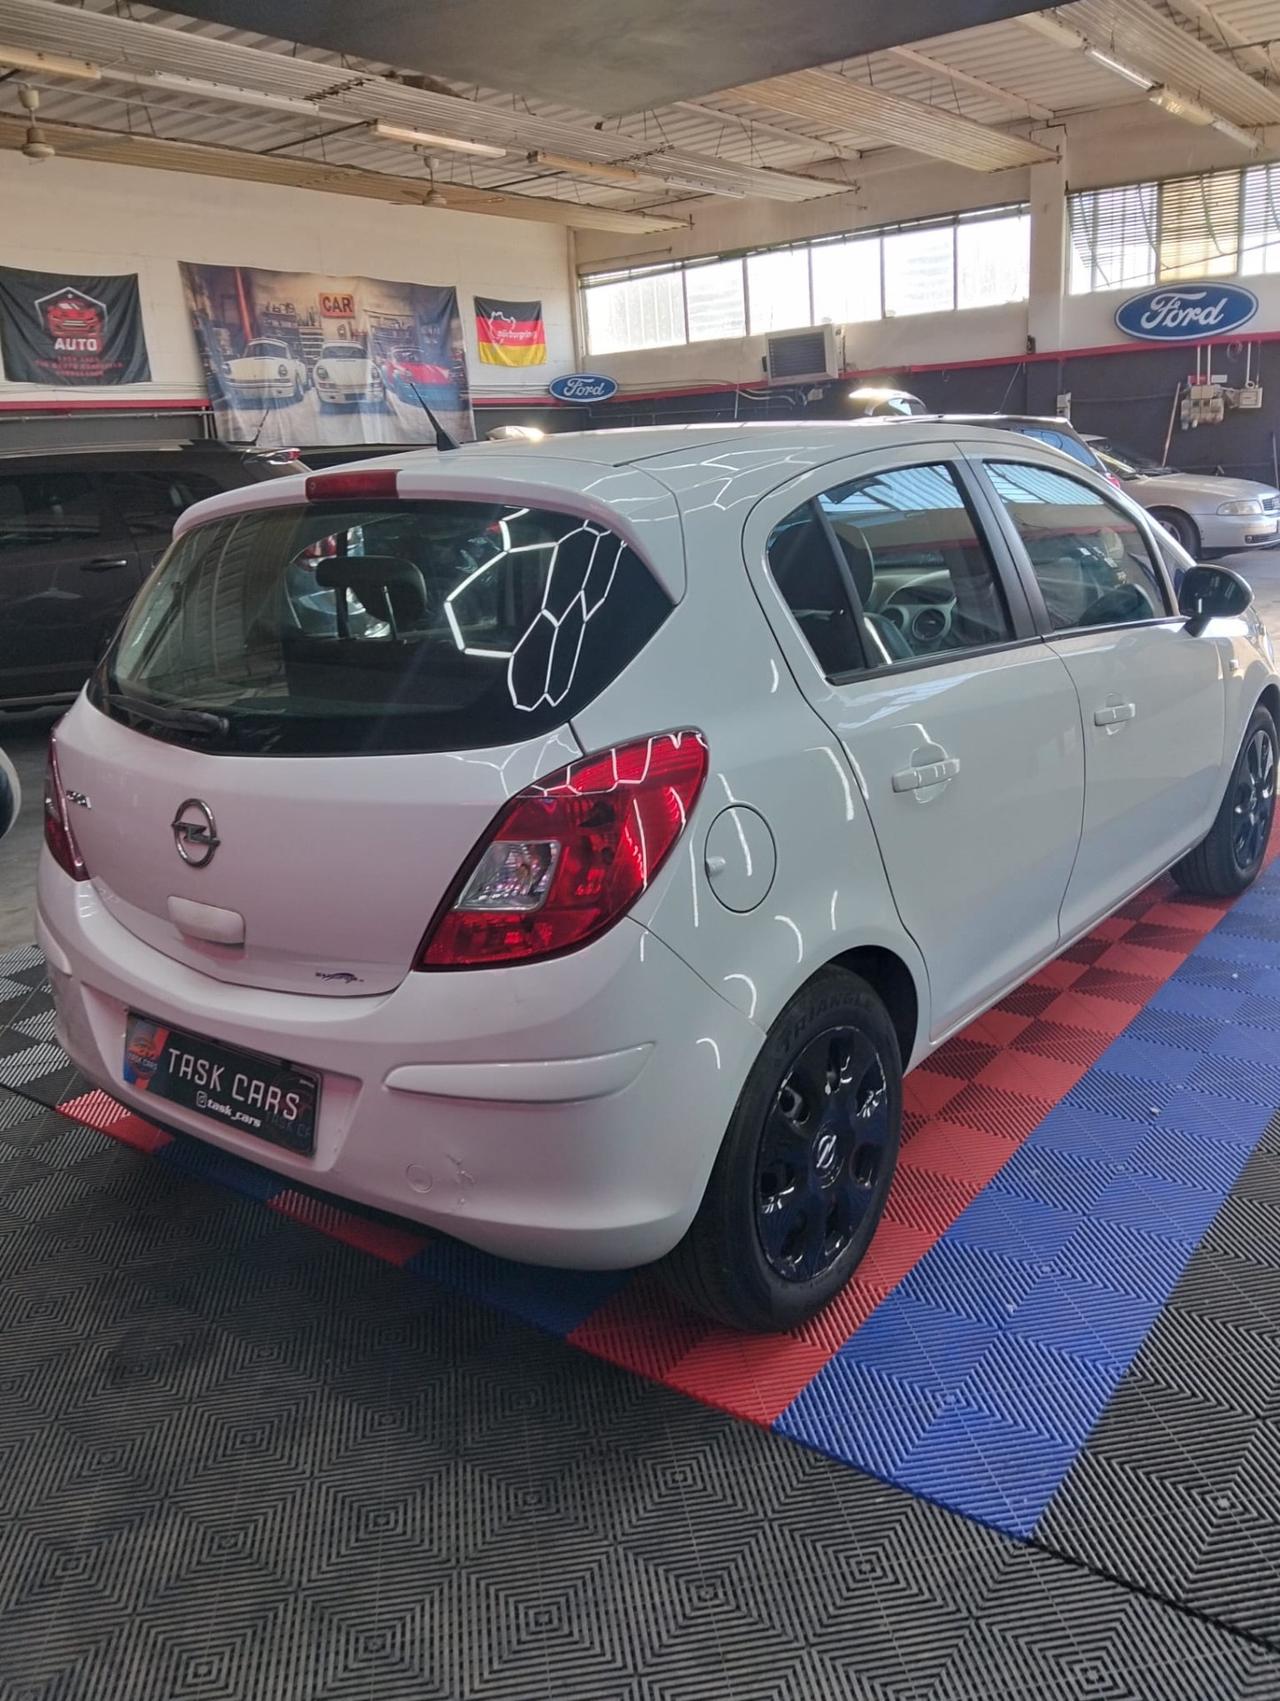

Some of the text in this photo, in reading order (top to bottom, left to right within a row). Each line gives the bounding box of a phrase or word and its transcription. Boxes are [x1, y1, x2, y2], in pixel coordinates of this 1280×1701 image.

[322, 295, 353, 313] CAR
[1141, 291, 1228, 329] Ford
[54, 338, 98, 351] AUTO
[563, 377, 605, 396] Ford
[168, 1048, 299, 1121] TASK CARS
[207, 1098, 262, 1128] task_cars
